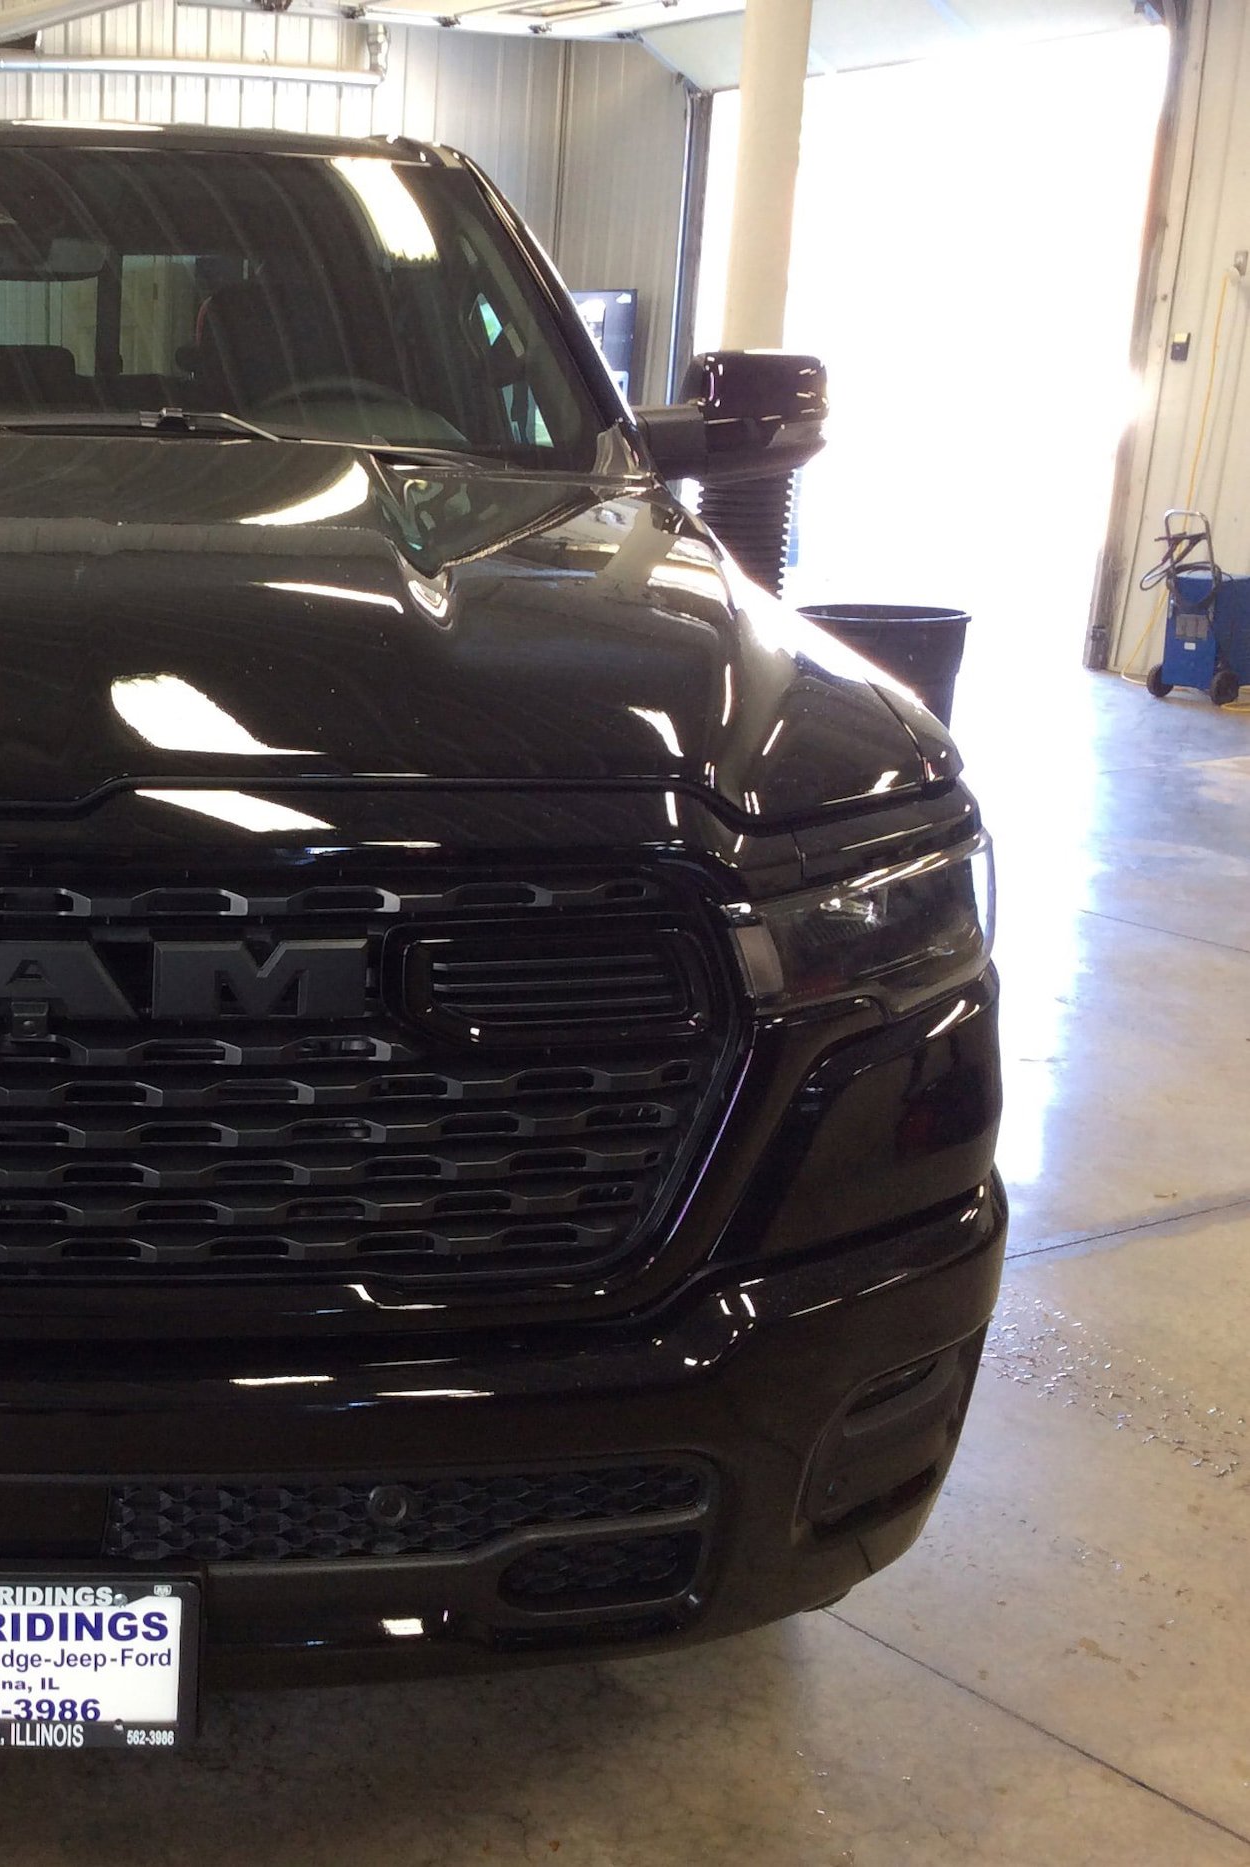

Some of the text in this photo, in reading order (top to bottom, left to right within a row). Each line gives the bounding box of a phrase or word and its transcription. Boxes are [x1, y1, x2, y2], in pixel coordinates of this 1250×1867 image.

[41, 1677, 60, 1690] IL
[11, 1723, 84, 1747] ILLINOIS
[126, 1730, 175, 1745] 562-3986
